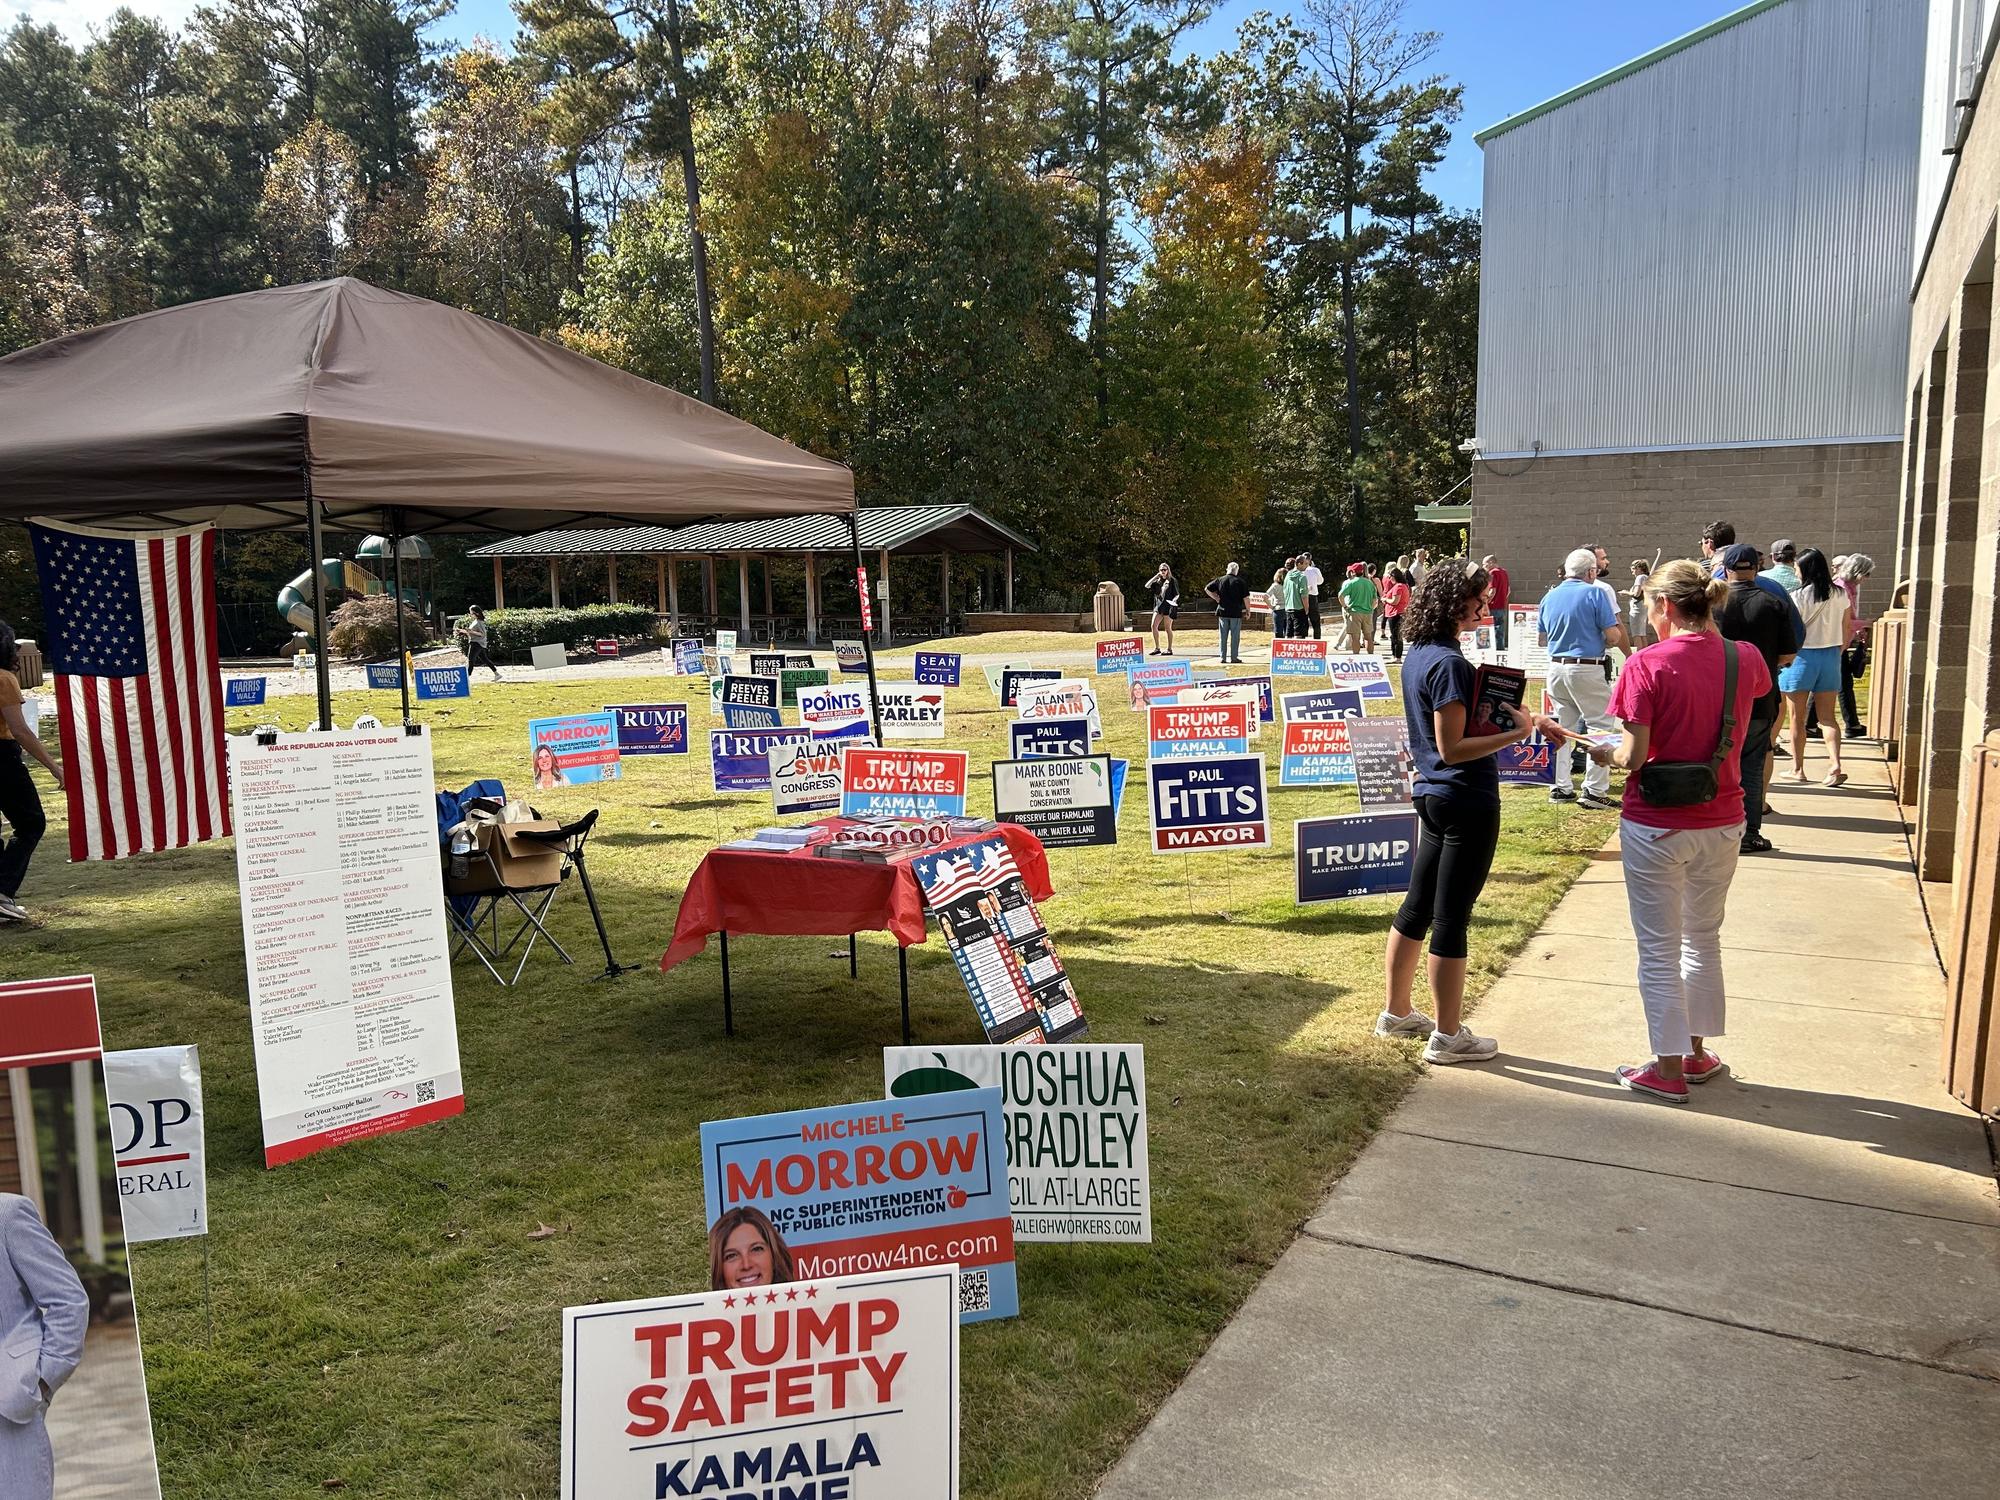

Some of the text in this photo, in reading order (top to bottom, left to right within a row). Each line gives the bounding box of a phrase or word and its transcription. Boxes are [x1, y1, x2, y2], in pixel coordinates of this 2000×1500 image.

[1104, 642, 1136, 650] TRUMP
[1100, 650, 1117, 658] LOW
[1107, 656, 1132, 664] KAMALA
[755, 659, 780, 667] REEVES
[921, 657, 955, 666] SEAN
[1331, 662, 1380, 673] POINTS
[371, 668, 398, 677] HARRIS
[422, 670, 460, 685] HARRIS
[920, 674, 954, 683] COLE
[1133, 668, 1185, 679] MORROW
[232, 680, 260, 693] HARRIS
[429, 684, 456, 692] WALZ
[731, 683, 769, 695] REEVES
[237, 692, 256, 700] WALZ
[730, 693, 769, 704] PEELER
[878, 695, 912, 706] LUKE
[1035, 694, 1065, 706] ALAN
[1203, 690, 1237, 701] Vote
[802, 694, 861, 712] POINTS
[1310, 698, 1335, 707] PAUL
[880, 708, 941, 720] FARLEY
[1035, 702, 1084, 716] SWAIN
[731, 709, 774, 727] HARRIS
[1166, 712, 1229, 726] TRUMP
[358, 720, 375, 730] VOTE
[538, 724, 610, 742] MORROW
[1037, 728, 1062, 737] PAUL
[1158, 726, 1239, 738] LOW TAXES
[1302, 729, 1348, 741] TRUM
[290, 742, 334, 750] REPUBLICAN
[354, 738, 376, 746] VOTER
[1172, 741, 1226, 752] KAMALA
[1291, 742, 1350, 753] LOW PRIC
[796, 743, 837, 759] ALAN
[558, 754, 615, 765] Morrow4nc.com
[795, 756, 841, 775] SWA
[1303, 756, 1352, 766] KAMALA
[866, 760, 945, 777] TRUMP
[1015, 762, 1083, 778] MARK BOONE
[1290, 766, 1356, 776] HIGH PRICE
[1188, 770, 1224, 782] PAUL
[781, 779, 835, 793] CONGRESS
[853, 778, 955, 792] LOW TAXES
[1030, 779, 1069, 788] WAKE COUNTY
[796, 793, 840, 802] SWAINFORCONG
[1051, 788, 1070, 796] WATER
[870, 797, 937, 809] KAMALA
[1030, 798, 1072, 807] CONSERVATION
[1158, 779, 1257, 820] FITTS
[1015, 810, 1094, 822] PRESERVE OUR FARMLAND
[1051, 827, 1071, 835] WATER
[1073, 826, 1076, 834] &
[1078, 825, 1094, 833] LAND
[1168, 827, 1255, 846] MAYOR
[1306, 840, 1410, 867] TRUMP
[1311, 866, 1329, 874] MAKE
[1331, 864, 1358, 872] AMERICA
[1360, 862, 1380, 870] GREAT
[346, 910, 385, 920] NONPARTISAN
[1001, 1051, 1138, 1106] JOSHUA
[332, 1102, 355, 1112] Sample
[356, 1097, 372, 1105] Ballot
[801, 1113, 905, 1143] MICHELE
[727, 1132, 979, 1203] MORROW
[1044, 1178, 1141, 1206] AT-LARGE
[770, 1188, 944, 1221] NC SUPERINTENDENT
[793, 1213, 846, 1233] PUBLIC
[849, 1202, 946, 1226] INSTRUCTION
[798, 1233, 998, 1280] Morrow4nc.com
[634, 1299, 900, 1378] TRUMP
[625, 1352, 908, 1437] SAFETY
[655, 1432, 881, 1500] KAMALA
